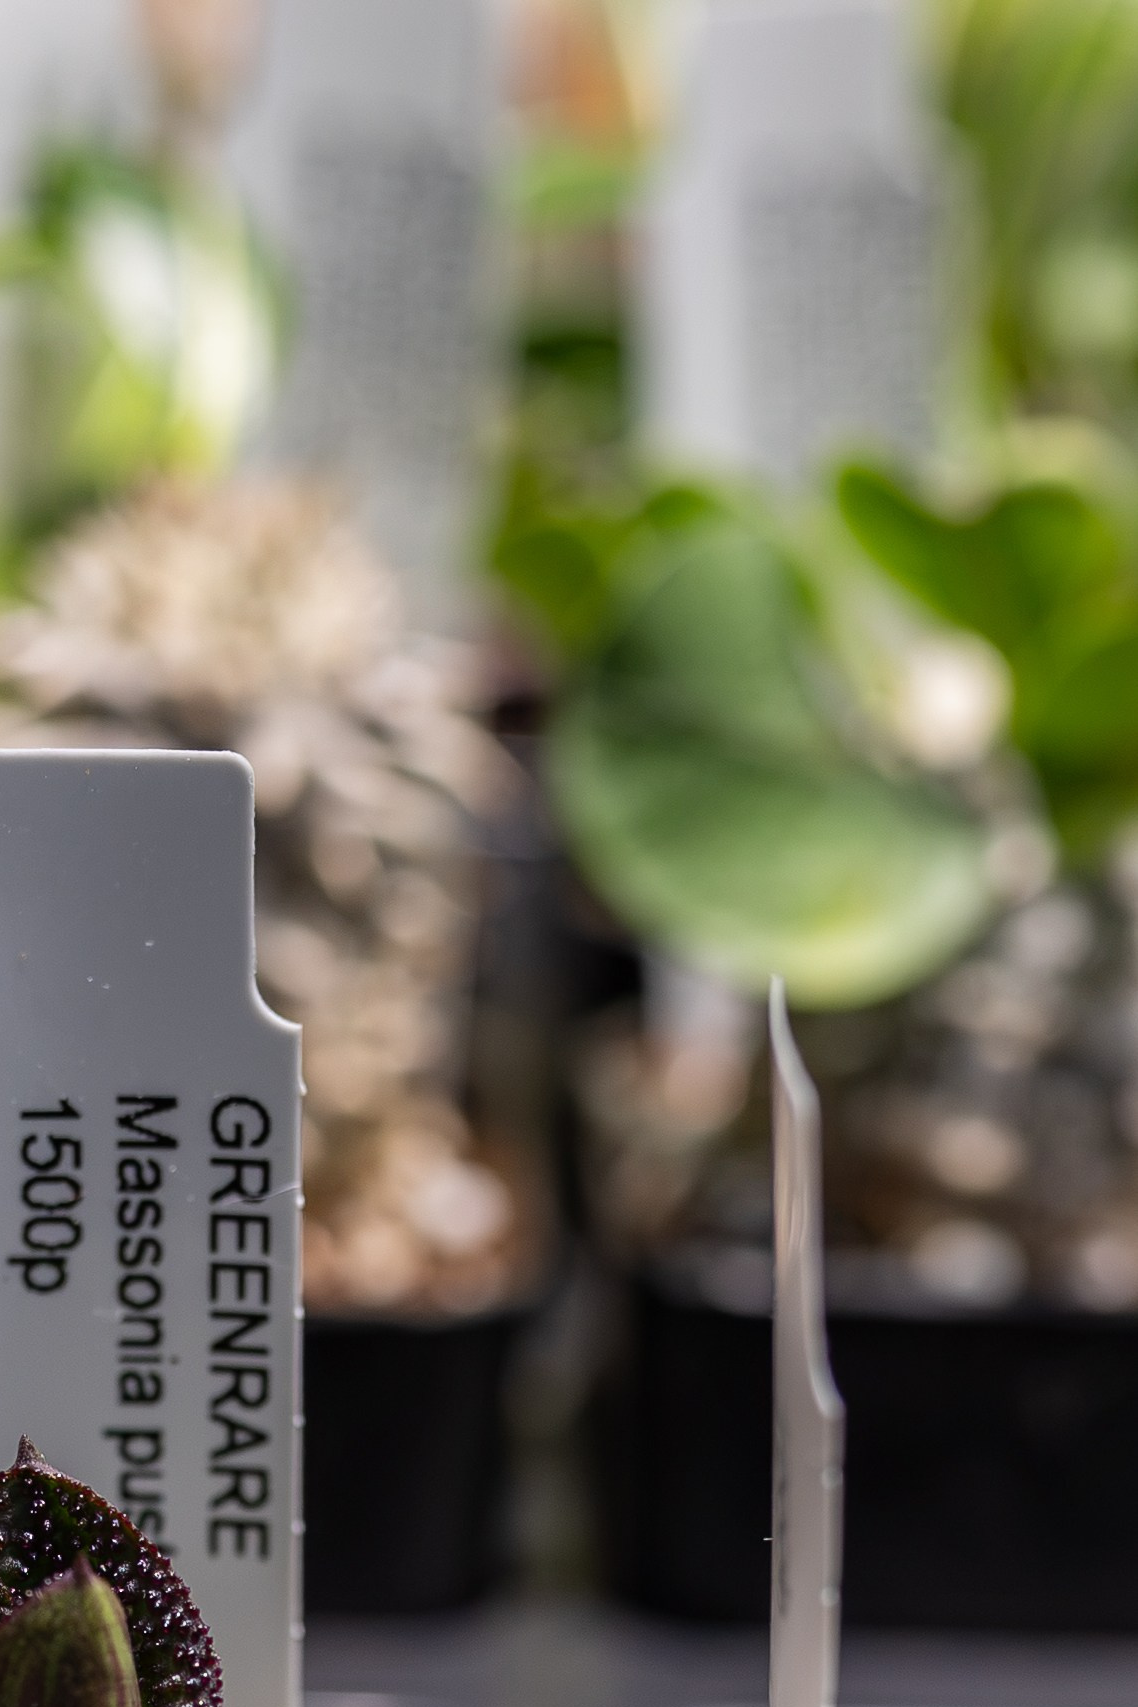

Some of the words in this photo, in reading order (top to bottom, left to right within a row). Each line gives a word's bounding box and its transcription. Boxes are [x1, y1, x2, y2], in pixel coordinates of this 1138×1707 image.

[7, 1098, 84, 1294] 1500p
[114, 1094, 179, 1405] Massonia
[208, 1095, 272, 1560] GREENRARE
[102, 1428, 177, 1555] pus
